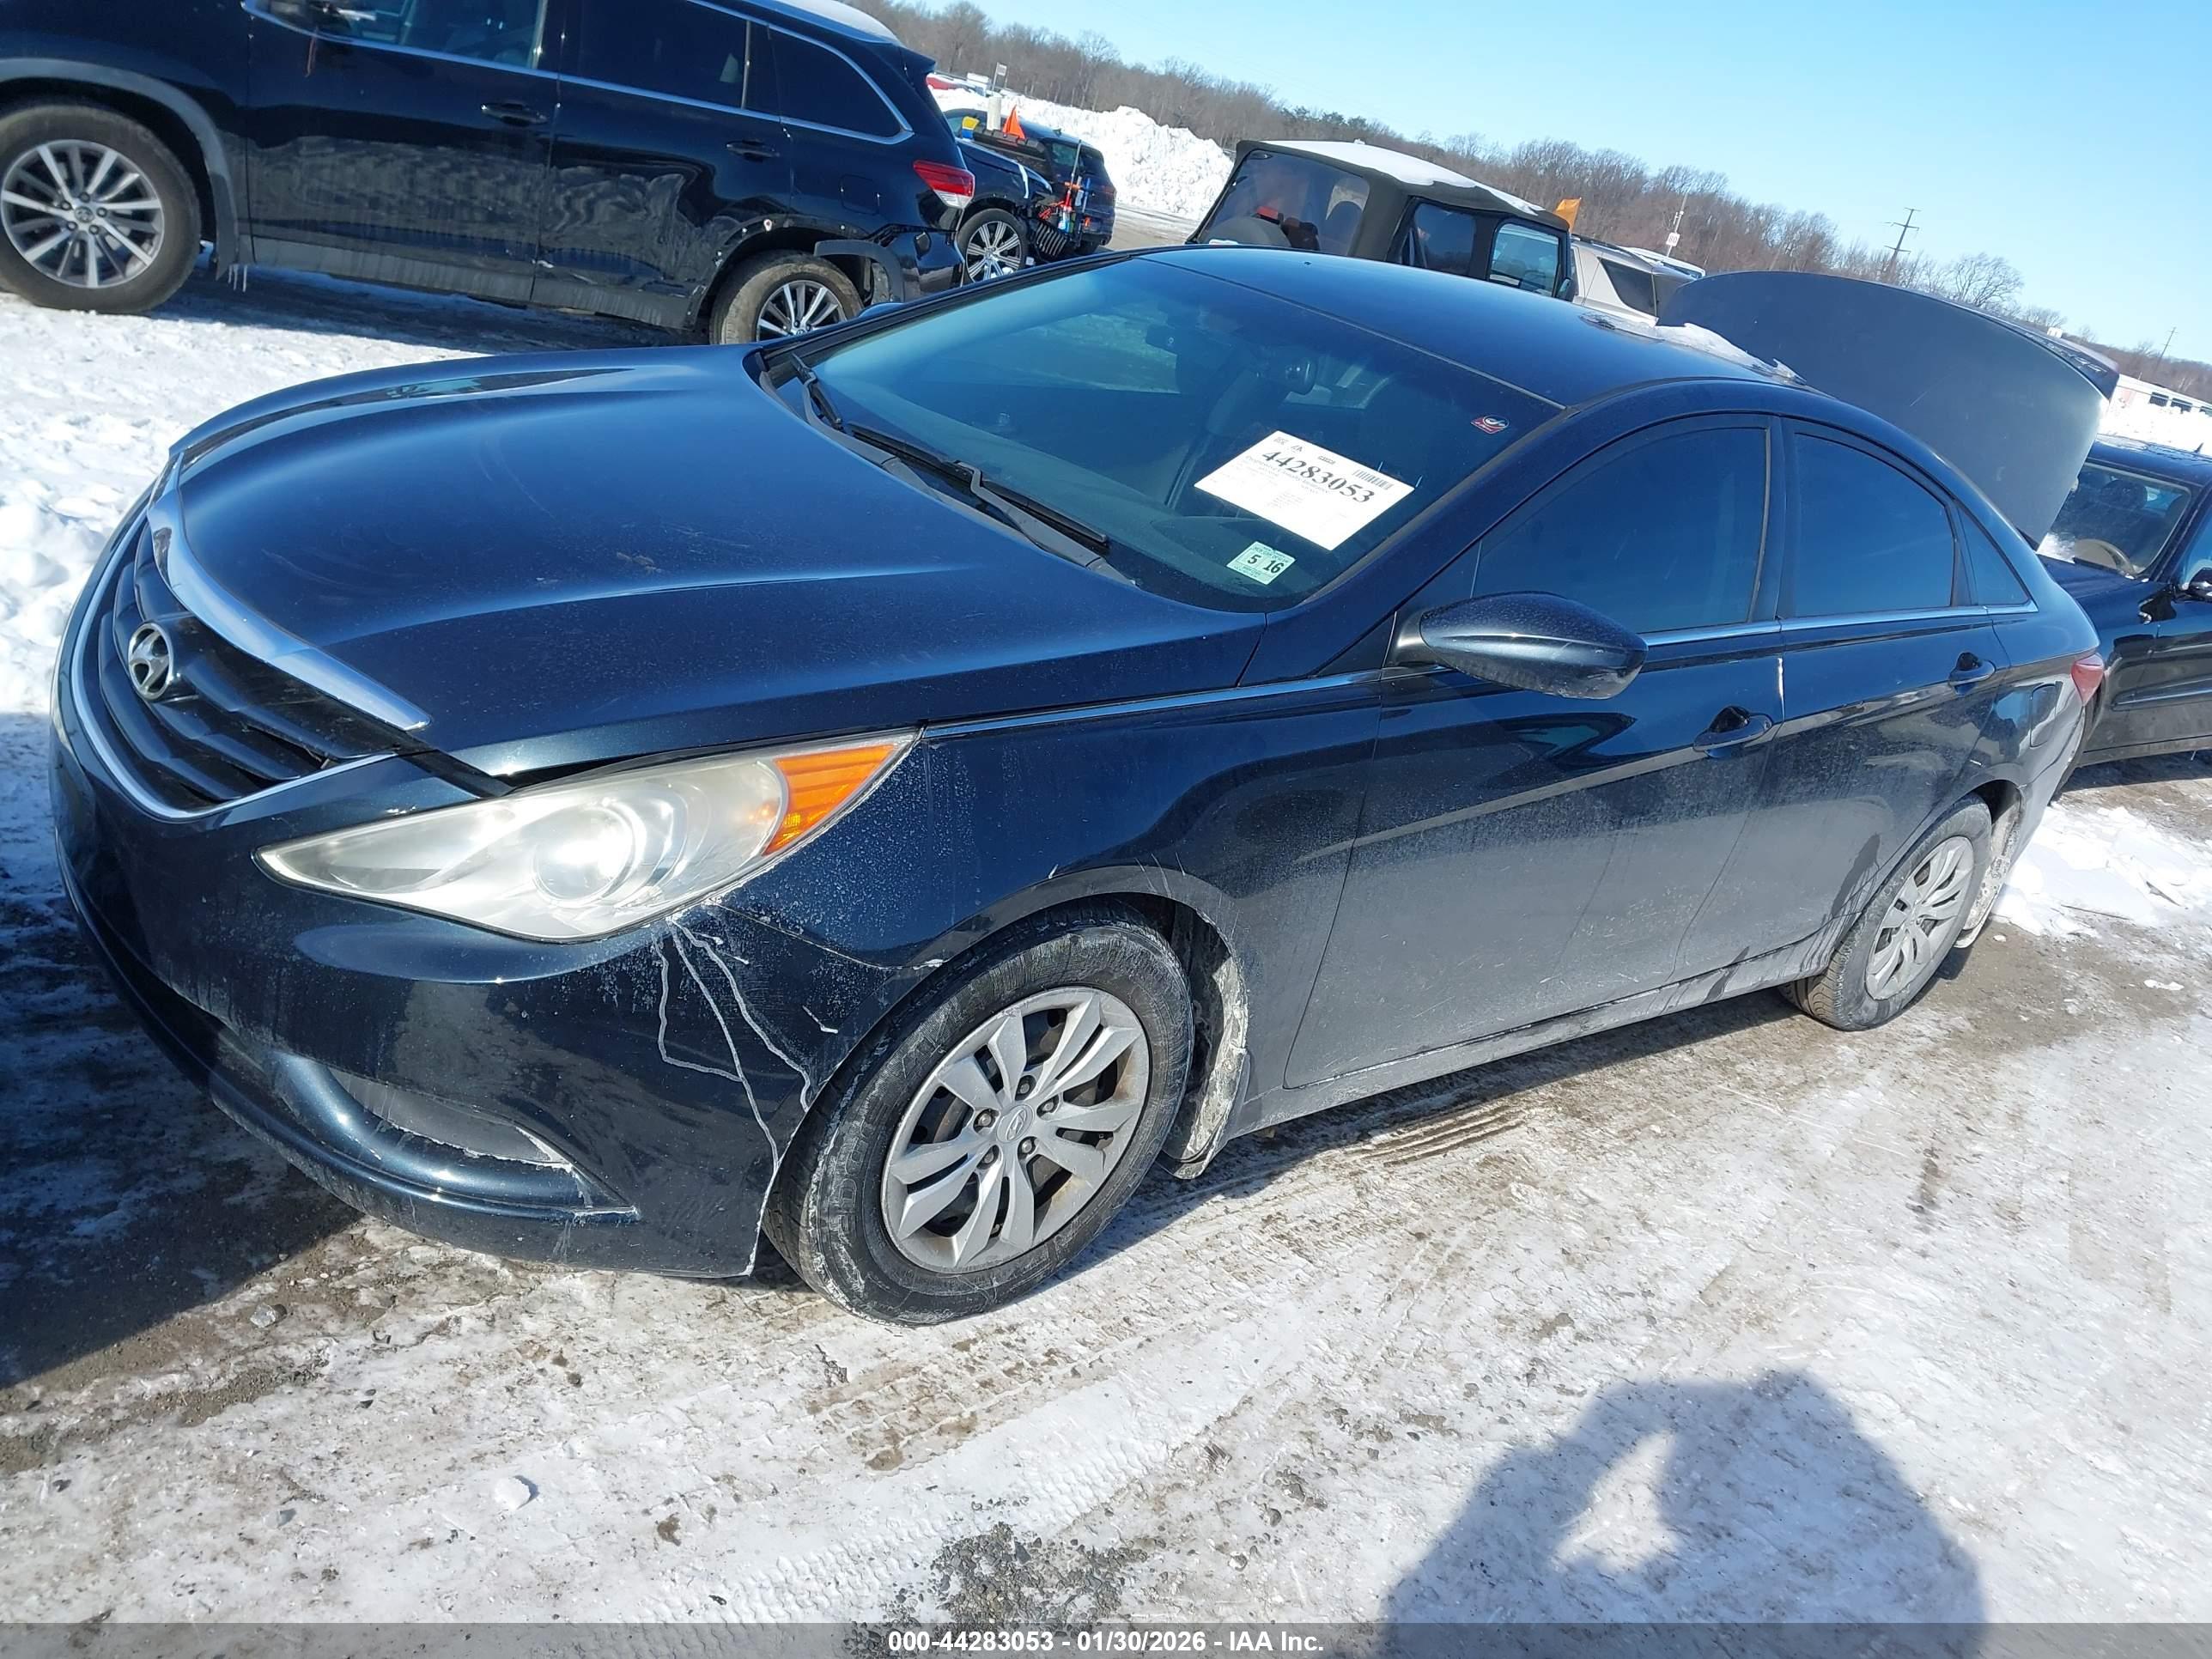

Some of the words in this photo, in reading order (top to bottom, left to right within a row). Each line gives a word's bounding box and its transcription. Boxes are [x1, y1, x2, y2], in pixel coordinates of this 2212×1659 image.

[1261, 451, 1376, 503] 44283053
[1247, 554, 1262, 565] 5
[1262, 560, 1285, 574] 16
